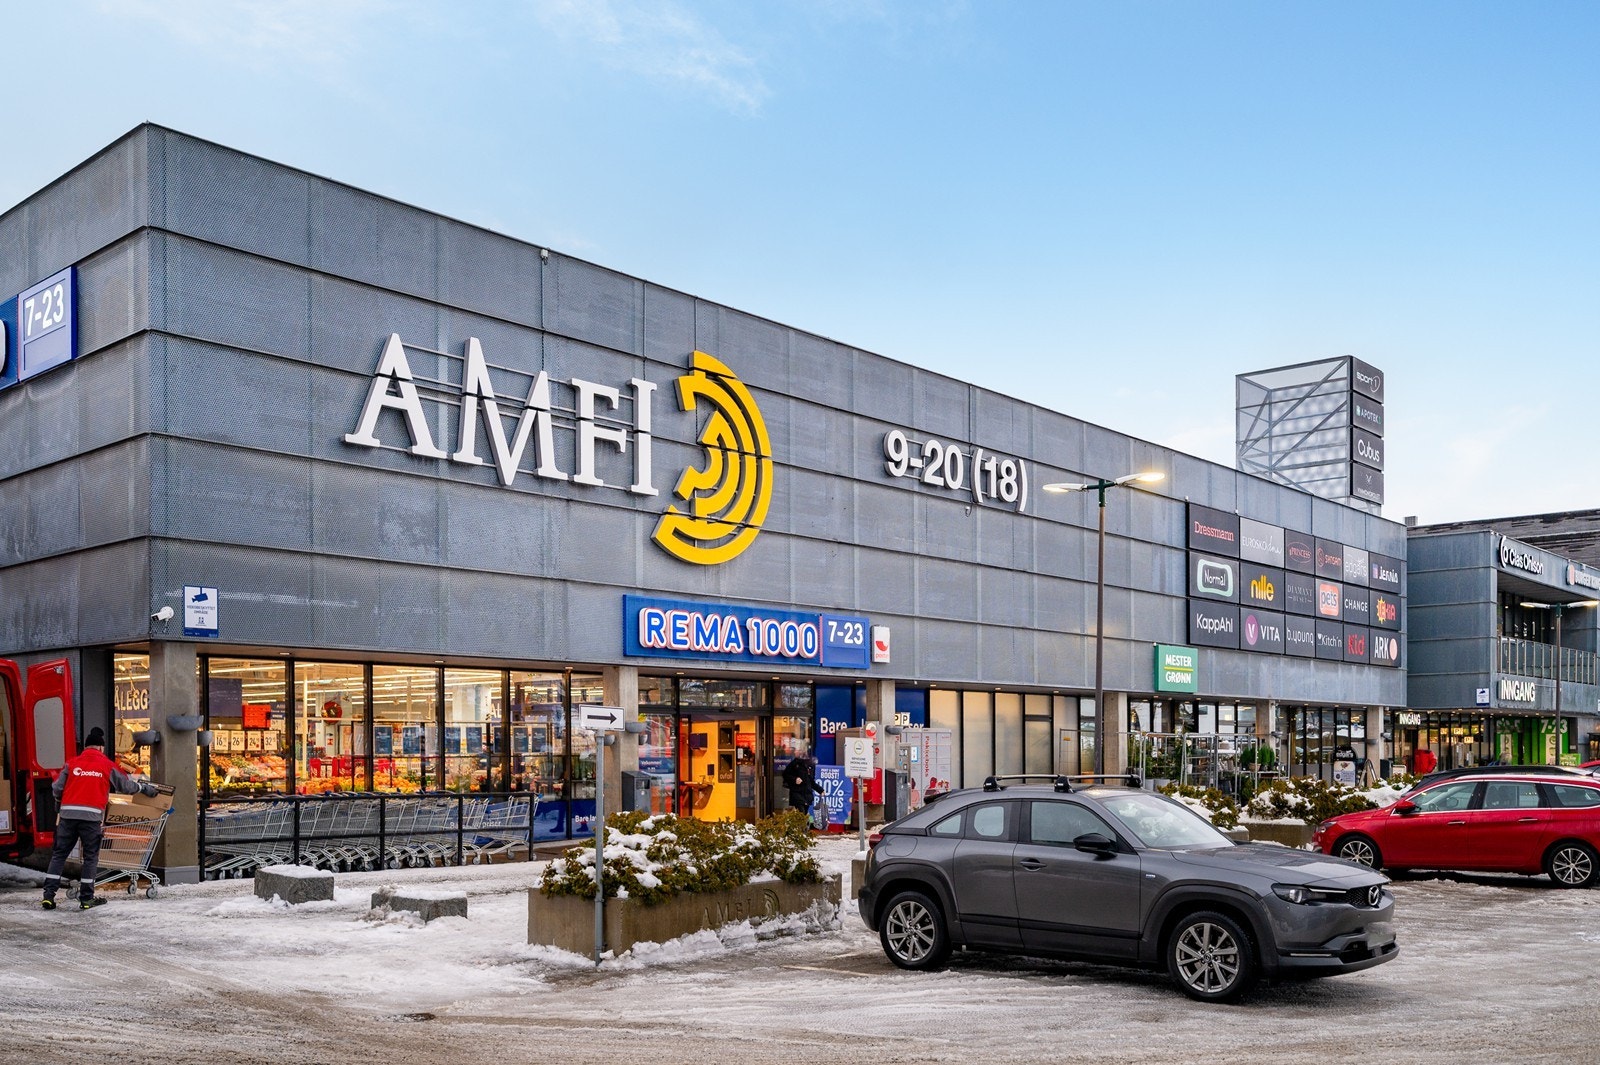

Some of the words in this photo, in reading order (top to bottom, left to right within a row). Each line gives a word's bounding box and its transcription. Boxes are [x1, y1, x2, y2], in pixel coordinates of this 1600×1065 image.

[25, 284, 64, 337] 7-23
[341, 333, 659, 496] AMFI
[1358, 439, 1380, 462] Cubus
[884, 430, 964, 490] 9-20
[971, 448, 1028, 512] (18)
[1194, 521, 1234, 541] Dressmann
[1509, 549, 1523, 568] Clas
[1523, 554, 1544, 575] Ohlson
[1204, 569, 1225, 586] Normal
[1250, 575, 1274, 601] nille
[1321, 591, 1337, 609] pets
[1344, 599, 1368, 612] CHANGE
[639, 607, 744, 653] REMA
[746, 617, 818, 658] 1000
[828, 621, 863, 645] 7-23
[1196, 613, 1233, 634] KappAhl
[1260, 625, 1280, 642] VITA
[1348, 633, 1365, 656] Kid
[1374, 636, 1389, 659] ARK
[1165, 654, 1192, 667] MESTER
[1165, 671, 1191, 684] GRØNN
[1501, 679, 1535, 702] INNGANG
[820, 717, 848, 734] Bare
[1400, 713, 1420, 725] INNGANG
[81, 770, 103, 778] posten
[814, 797, 844, 808] BNUS
[108, 814, 150, 823] zalando
